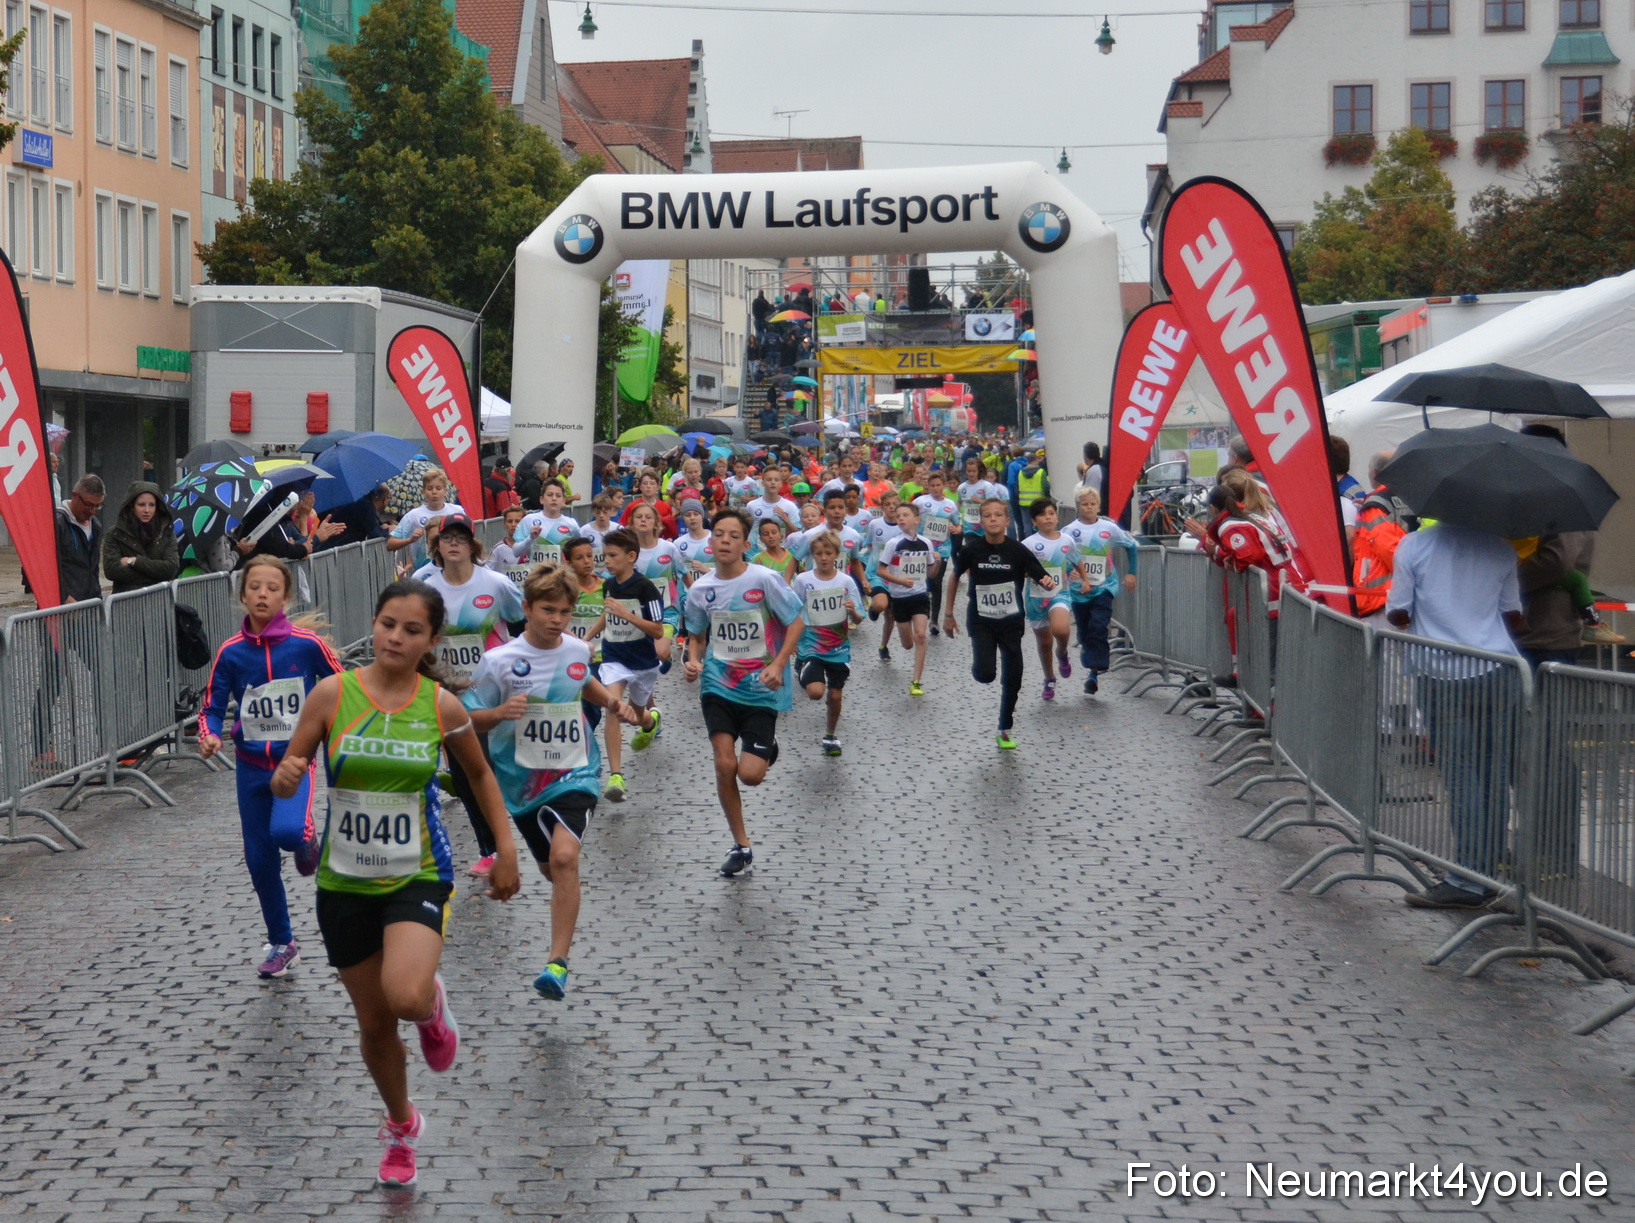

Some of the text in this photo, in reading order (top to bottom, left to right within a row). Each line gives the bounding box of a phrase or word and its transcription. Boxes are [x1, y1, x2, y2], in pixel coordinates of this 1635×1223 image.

[621, 185, 1000, 233] BMW Laufsport
[1022, 201, 1067, 221] BMW
[557, 214, 599, 235] BMW
[896, 352, 942, 369] ZIEL
[1118, 319, 1188, 442] REWE
[514, 421, 584, 431] www.bmw-laufsport.de
[1050, 412, 1110, 423] www.bmw-laufspo
[966, 508, 981, 517] 403
[926, 521, 947, 534] 4000
[902, 562, 926, 575] 4042
[977, 562, 1011, 570] STANNO
[1083, 562, 1103, 575] 003
[811, 595, 844, 612] 4107
[981, 590, 1013, 607] 4043
[717, 622, 760, 641] 4052
[441, 646, 482, 666] 4008
[247, 692, 300, 719] 4019
[523, 718, 581, 744] 4046
[339, 734, 430, 762] BOCK
[543, 750, 561, 760] Tim
[338, 810, 411, 845] 4040
[356, 853, 388, 867] Helin
